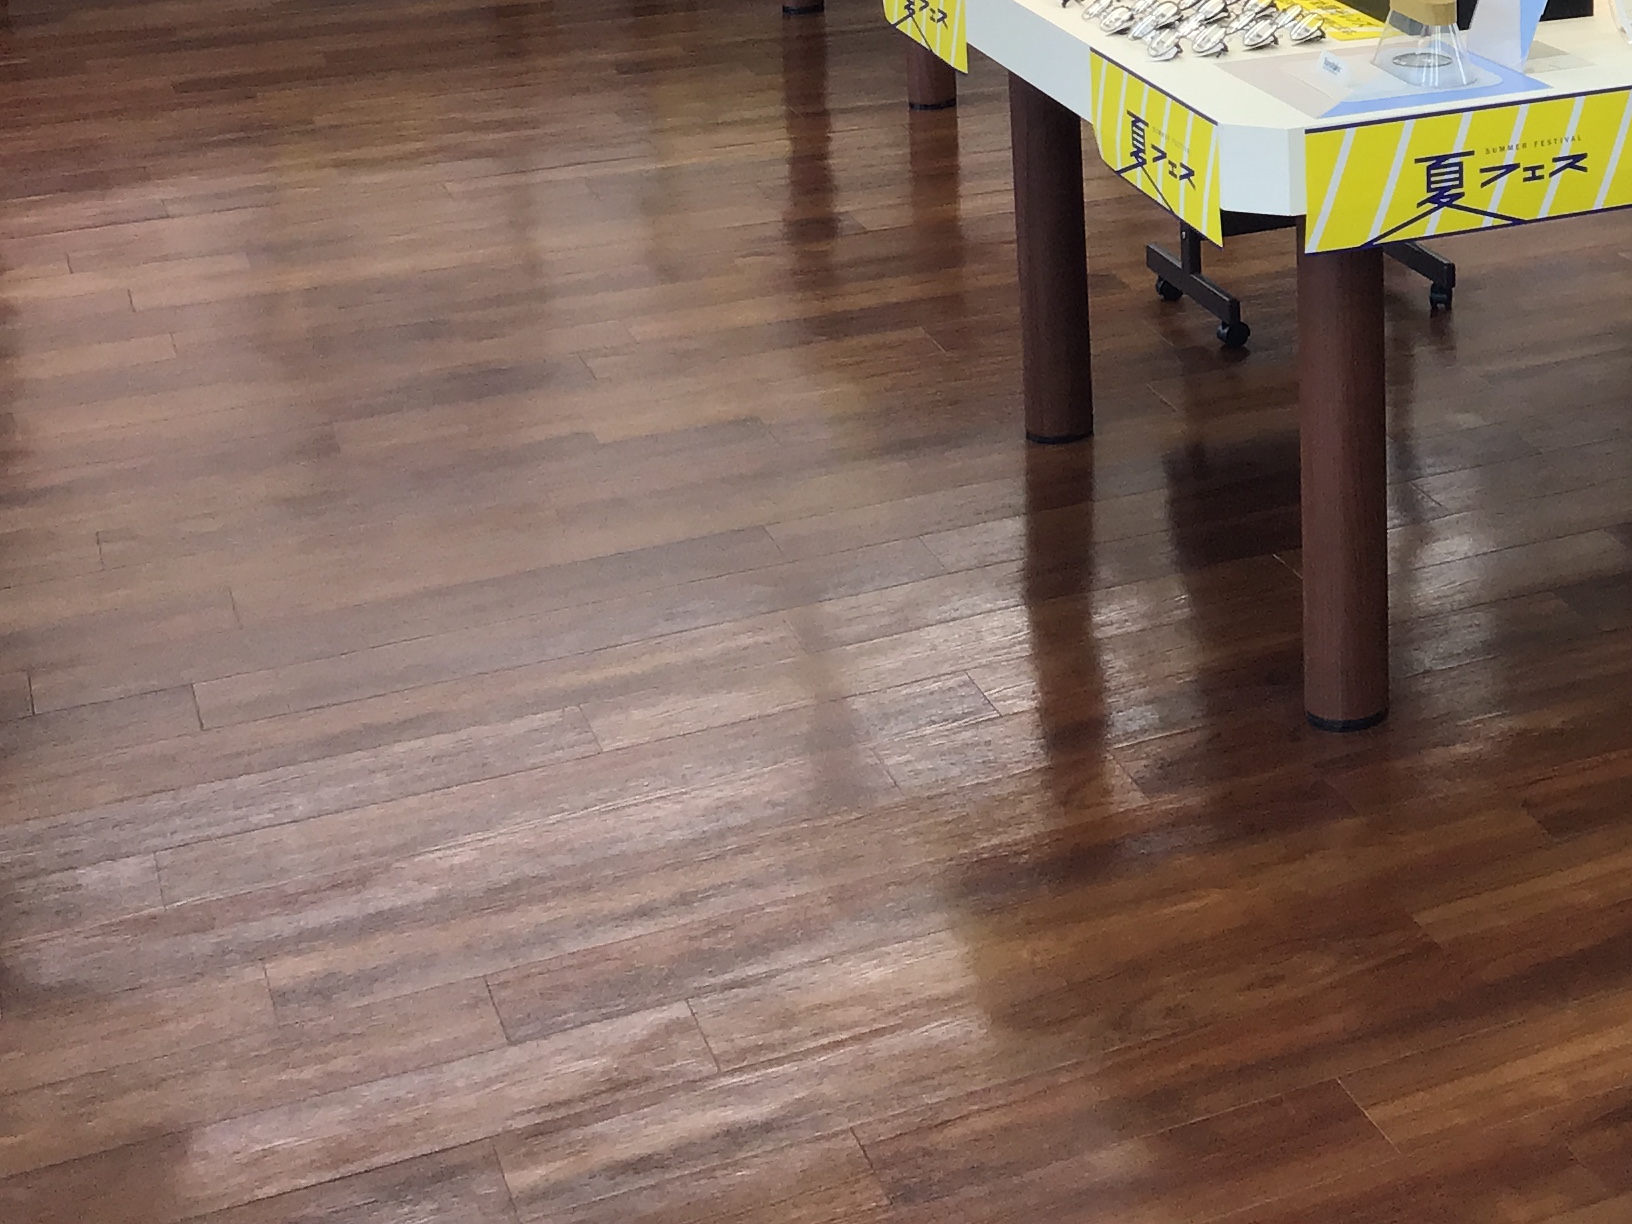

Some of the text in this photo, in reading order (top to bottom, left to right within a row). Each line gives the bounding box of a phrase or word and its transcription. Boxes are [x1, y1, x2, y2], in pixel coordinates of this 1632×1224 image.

[1117, 110, 1196, 202] 夏フェス
[1485, 134, 1582, 155] SUMMER FESTIVAL
[1386, 149, 1589, 230] 夏フェス
